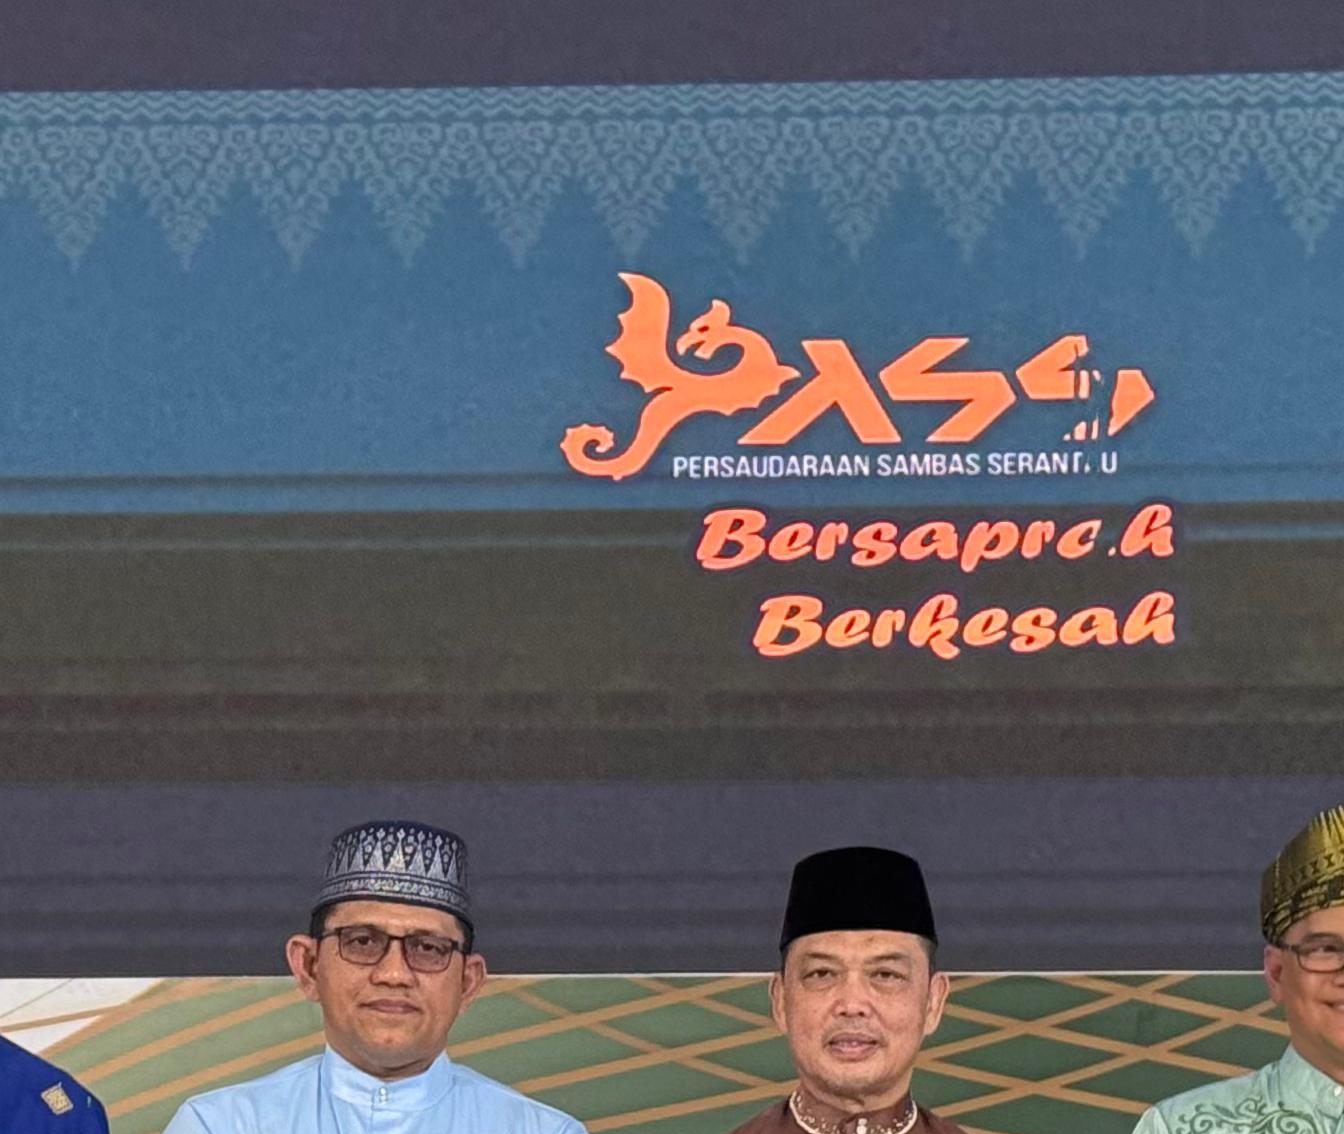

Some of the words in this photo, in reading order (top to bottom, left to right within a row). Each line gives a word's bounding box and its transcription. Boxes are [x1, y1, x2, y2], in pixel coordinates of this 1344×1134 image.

[673, 456, 869, 478] PERSAUDARAAN
[877, 453, 980, 476] SAMBAS
[988, 451, 1118, 475] SERANTU
[753, 592, 1175, 659] Berkesah
